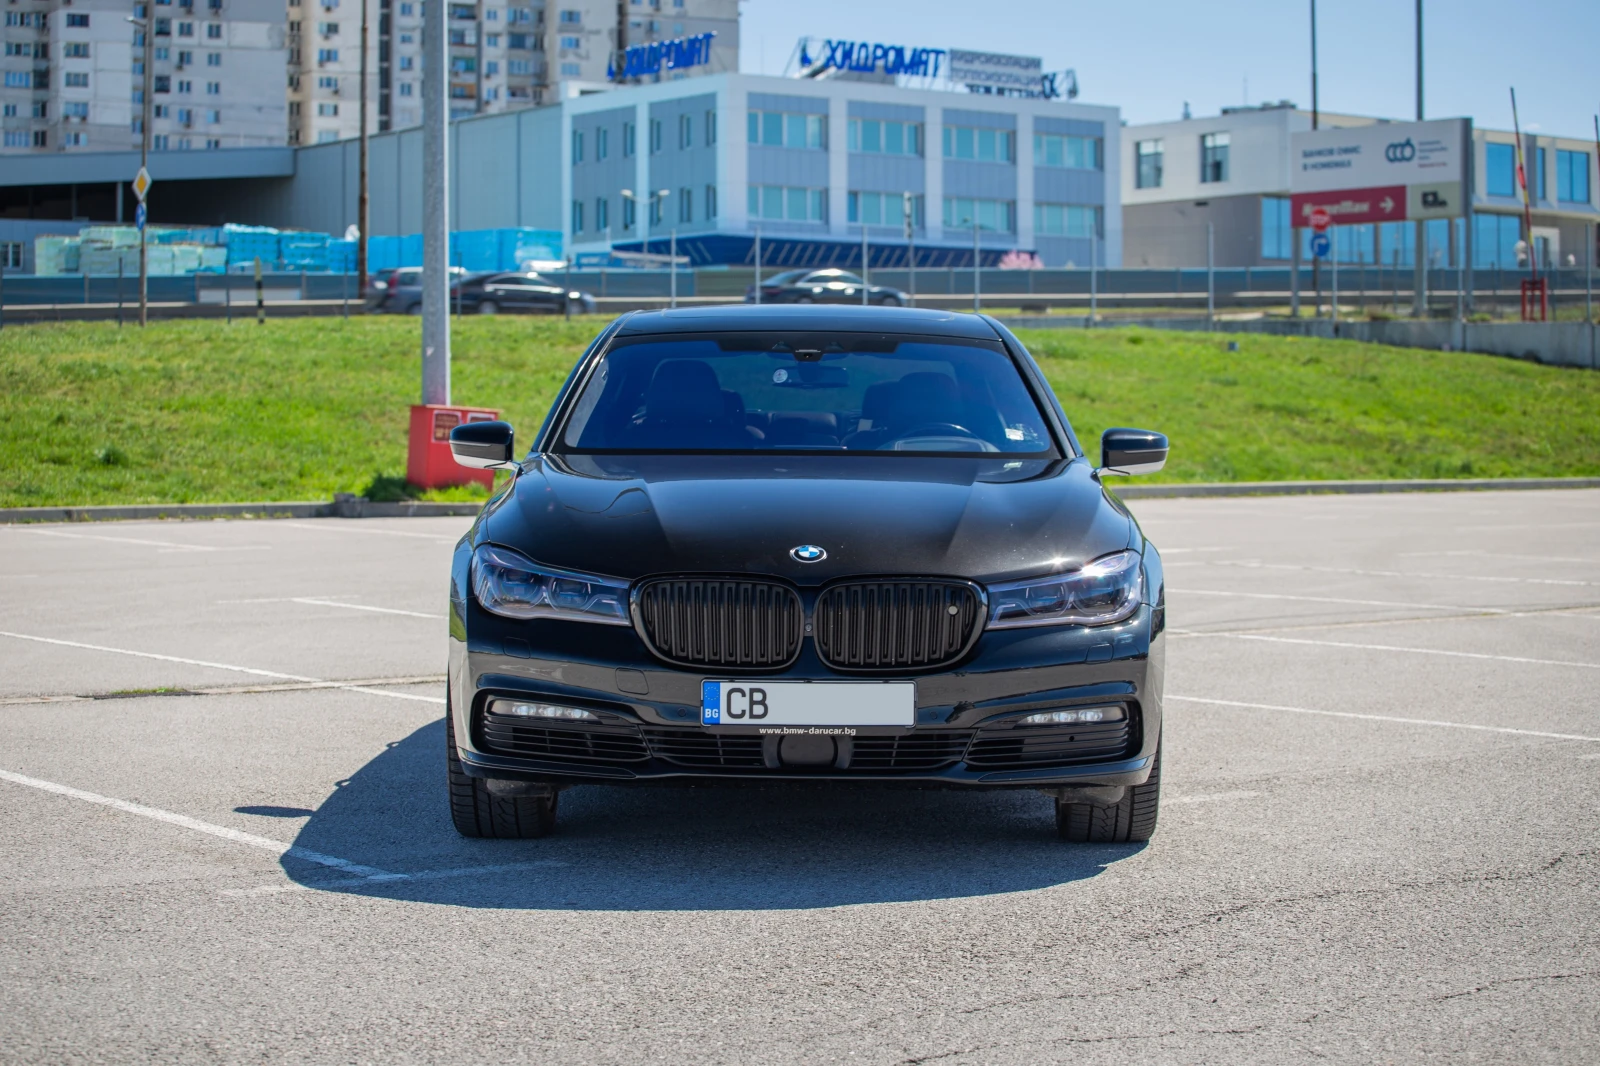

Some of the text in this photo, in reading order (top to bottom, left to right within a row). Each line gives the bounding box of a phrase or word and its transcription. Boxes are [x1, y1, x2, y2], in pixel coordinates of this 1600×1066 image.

[824, 39, 945, 77] ХИДРОМАТ
[704, 708, 719, 718] BG
[726, 687, 769, 720] CB
[759, 726, 857, 736] www.bmw-darucar.bg
